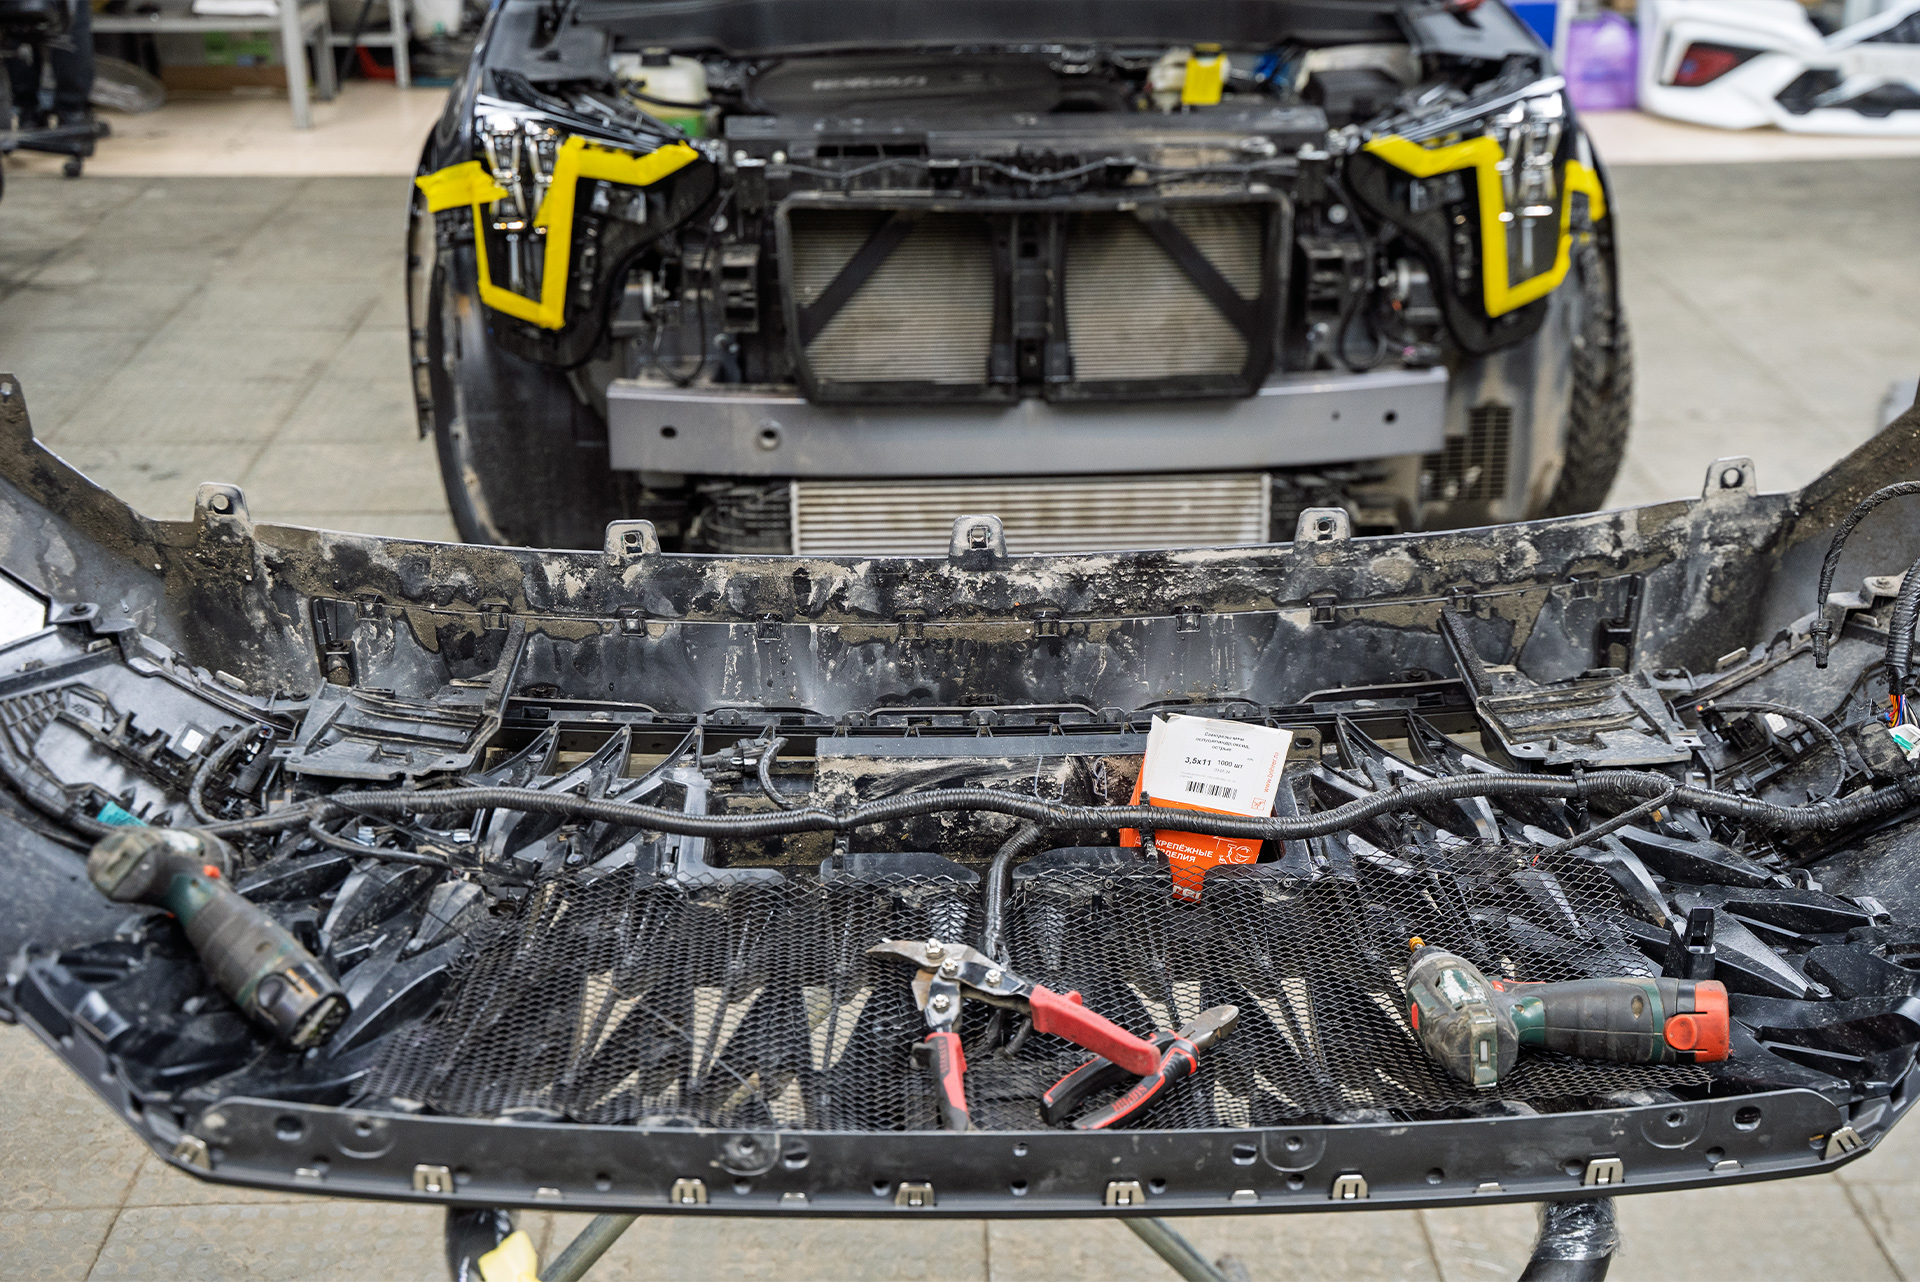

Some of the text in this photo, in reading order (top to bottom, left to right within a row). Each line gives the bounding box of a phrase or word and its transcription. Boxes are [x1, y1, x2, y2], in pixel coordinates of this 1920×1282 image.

[1217, 759, 1233, 767] 1000
[1155, 839, 1214, 858] КРЕПЁЖНЫЕ
[1156, 847, 1196, 863] ДЕЛИЯ
[937, 1038, 950, 1074] STANLEY
[1111, 1084, 1148, 1112] SUPER
